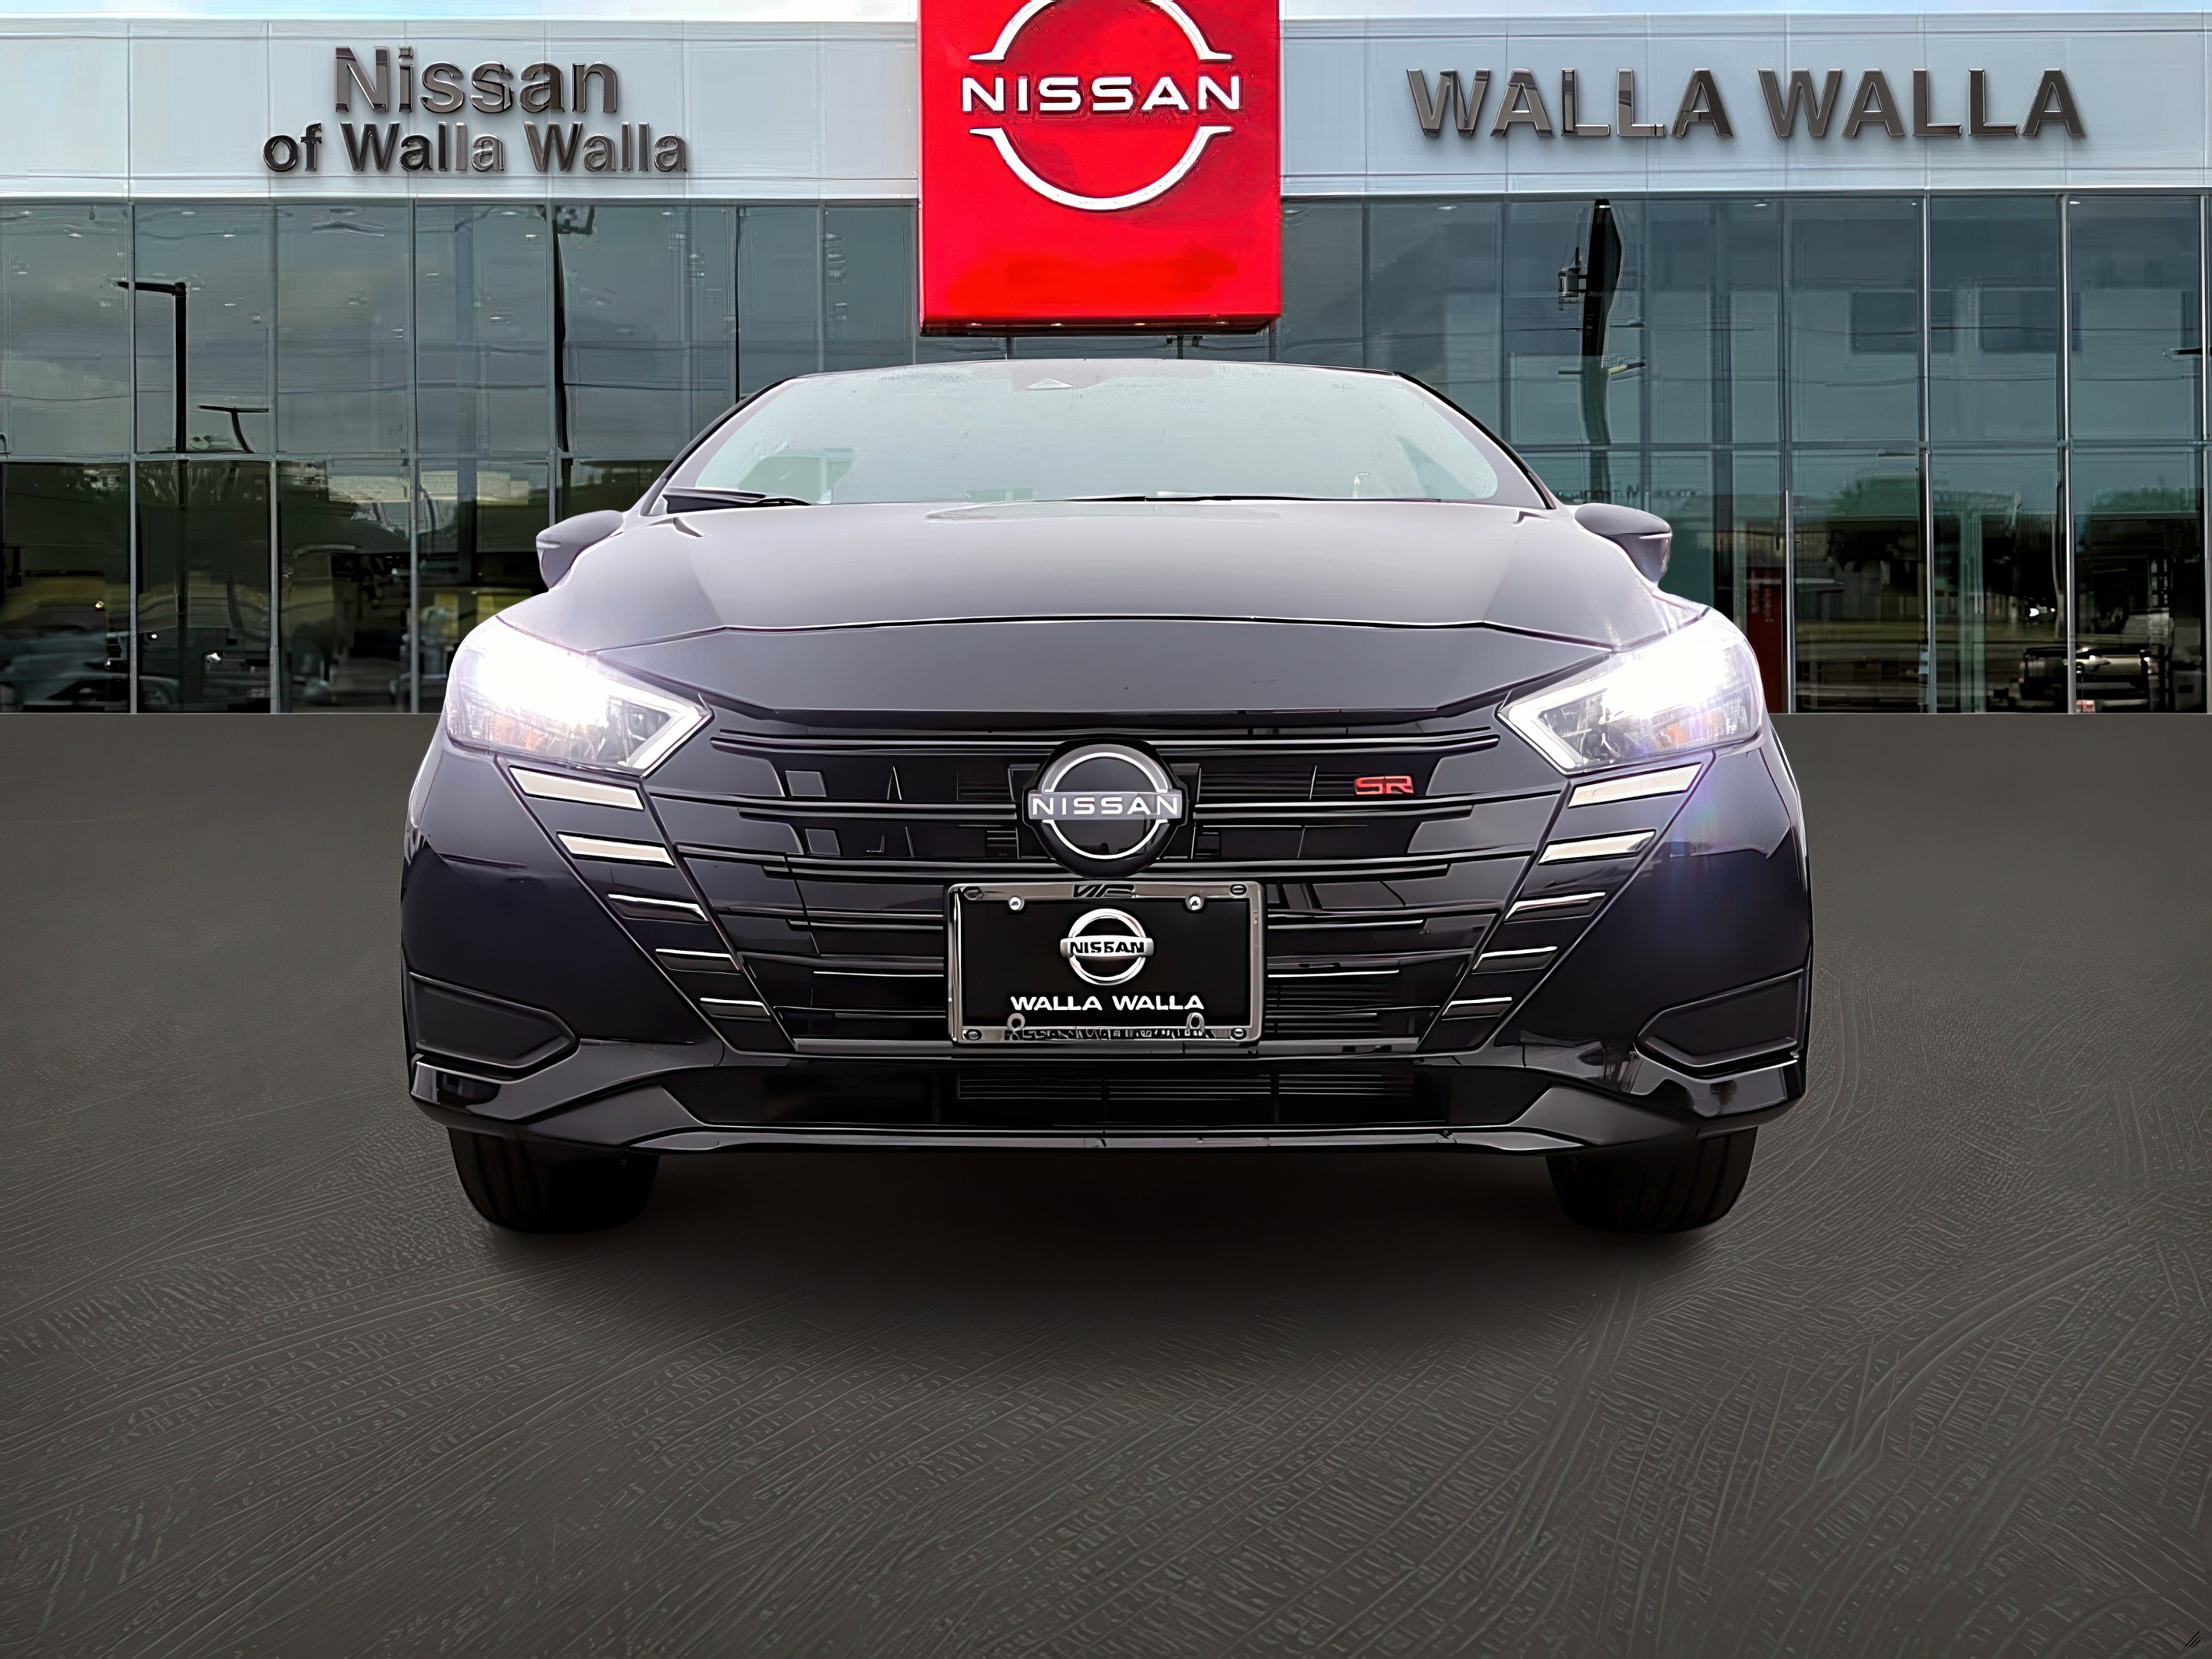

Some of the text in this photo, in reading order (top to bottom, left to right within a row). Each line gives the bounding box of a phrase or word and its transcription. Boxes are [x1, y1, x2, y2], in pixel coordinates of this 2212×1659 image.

[334, 45, 619, 113] Nissan
[962, 75, 1240, 112] NISSAN
[1406, 68, 2086, 139] WALLA WALLA
[262, 121, 688, 173] of Walla Walla
[1355, 776, 1414, 795] SR
[1031, 795, 1178, 816] NISSAN
[1070, 941, 1145, 954] NISSAN
[1010, 995, 1205, 1011] WALLA WALLA
